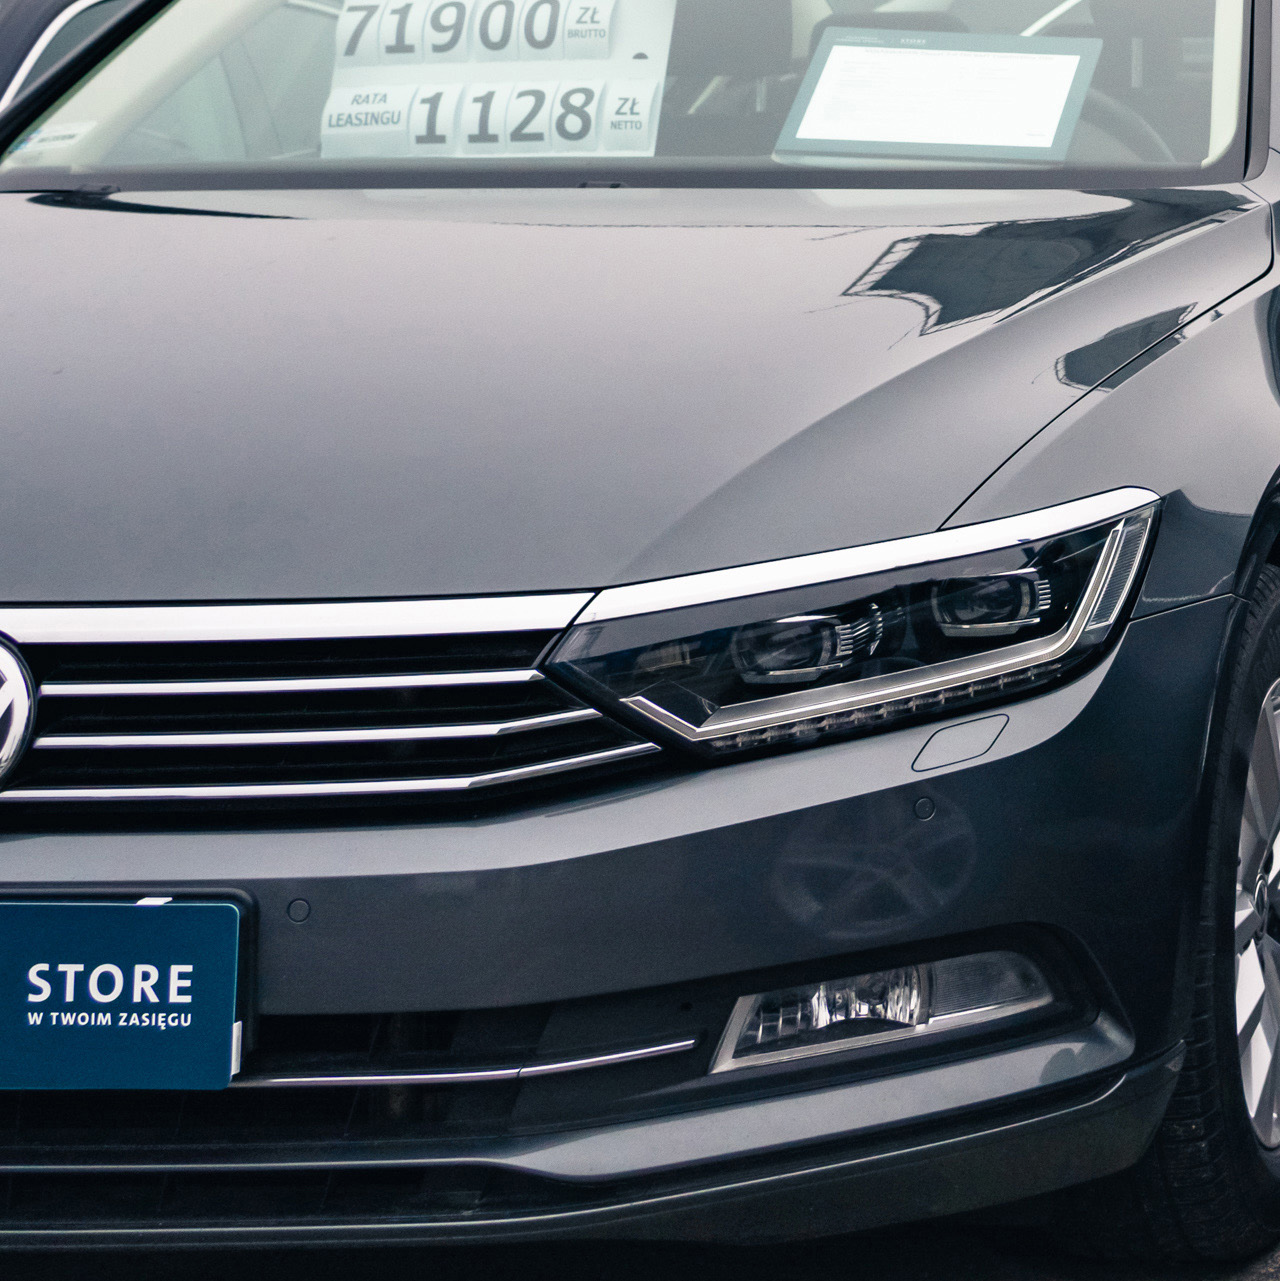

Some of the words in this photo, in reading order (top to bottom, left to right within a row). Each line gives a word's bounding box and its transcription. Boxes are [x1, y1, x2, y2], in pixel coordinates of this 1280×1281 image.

[575, 6, 602, 24] ZŁ
[567, 28, 607, 39] BRUTTO
[351, 92, 388, 106] RATA
[328, 110, 402, 128] LEASINGU
[415, 87, 596, 145] 1128
[614, 97, 641, 117] ZŁ
[610, 120, 642, 131] NETTO
[27, 963, 193, 1003] STORE
[27, 1012, 44, 1026] W
[50, 1012, 112, 1027] TWOIM
[118, 1012, 192, 1031] ZASIĘGU
